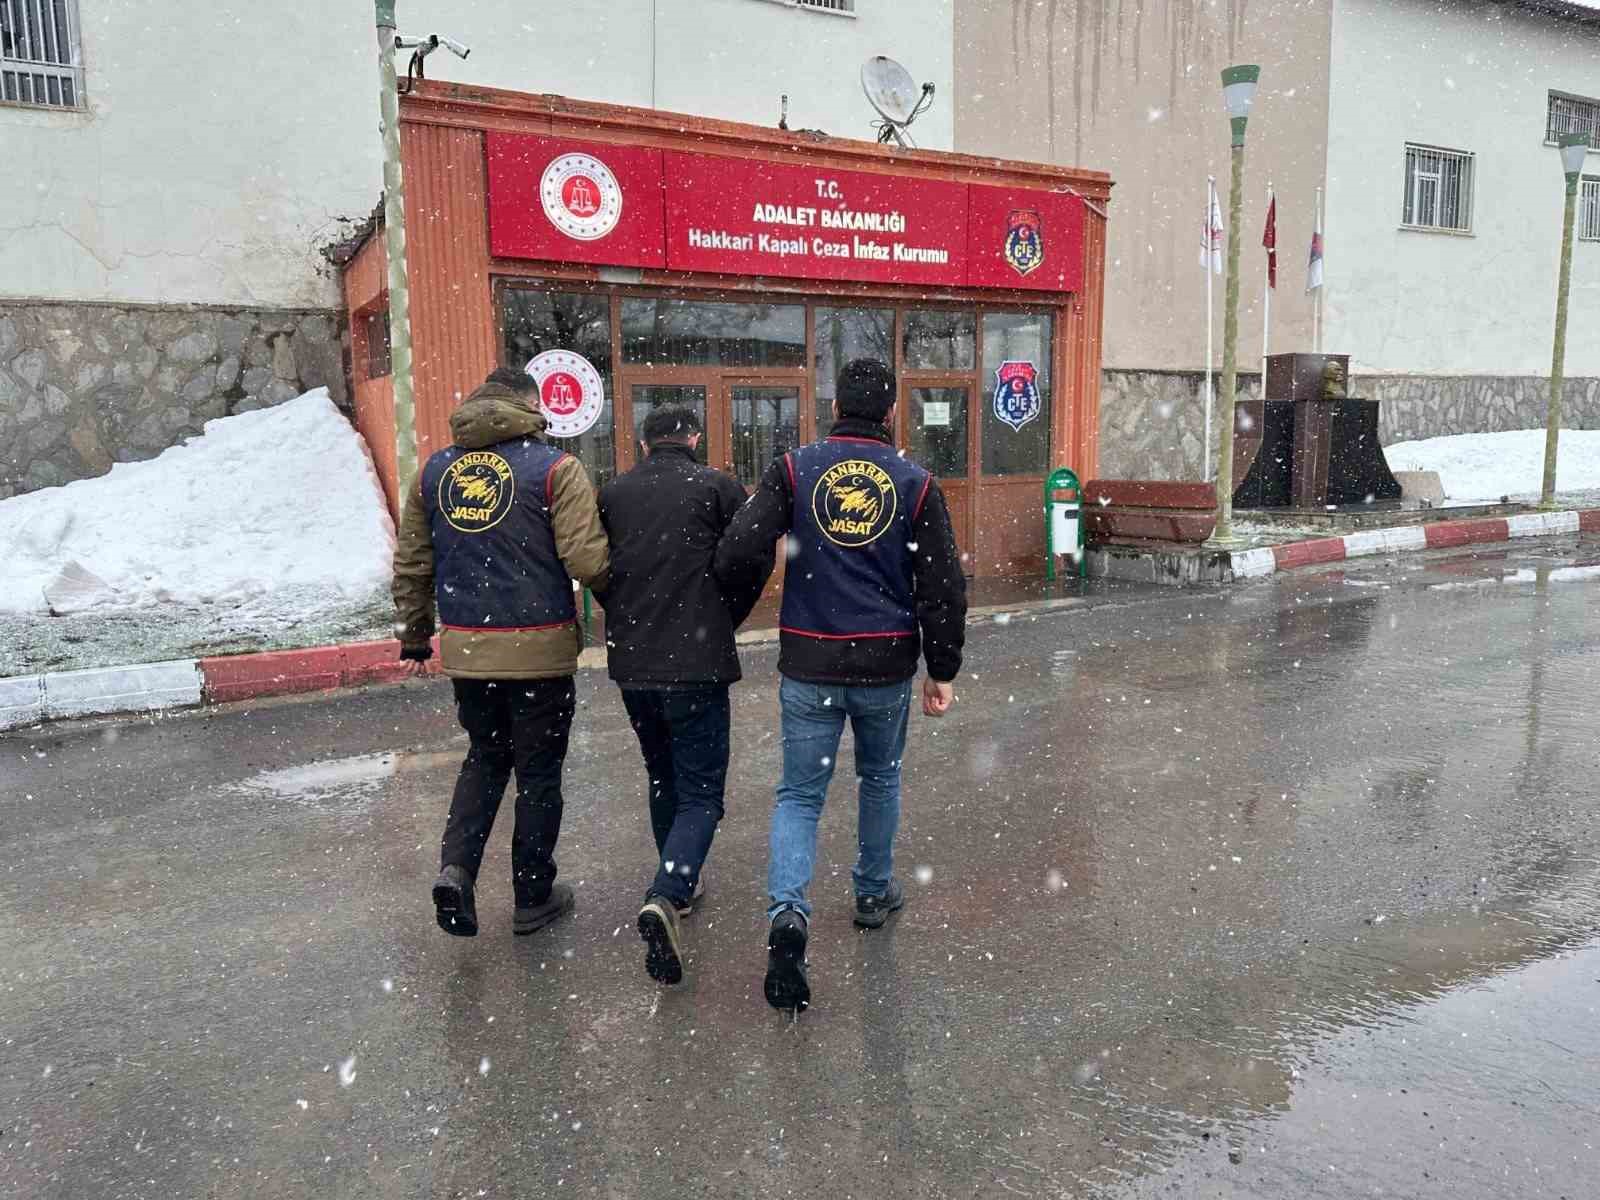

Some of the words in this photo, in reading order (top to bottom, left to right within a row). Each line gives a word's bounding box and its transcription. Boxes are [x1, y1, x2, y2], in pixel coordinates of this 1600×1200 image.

[815, 179, 843, 199] T.C.
[753, 203, 816, 226] ADALET
[821, 209, 905, 233] BAKANLIĞI
[688, 228, 752, 250] Hakkari
[758, 233, 808, 257] Kapalı
[813, 238, 849, 258] Ceza
[854, 235, 890, 260] İnfaz
[893, 244, 948, 263] Kurumu
[451, 454, 511, 481] JANDARMA
[824, 463, 891, 493] JANDARMA
[451, 506, 491, 521] JASAT
[828, 519, 873, 535] JASAT
